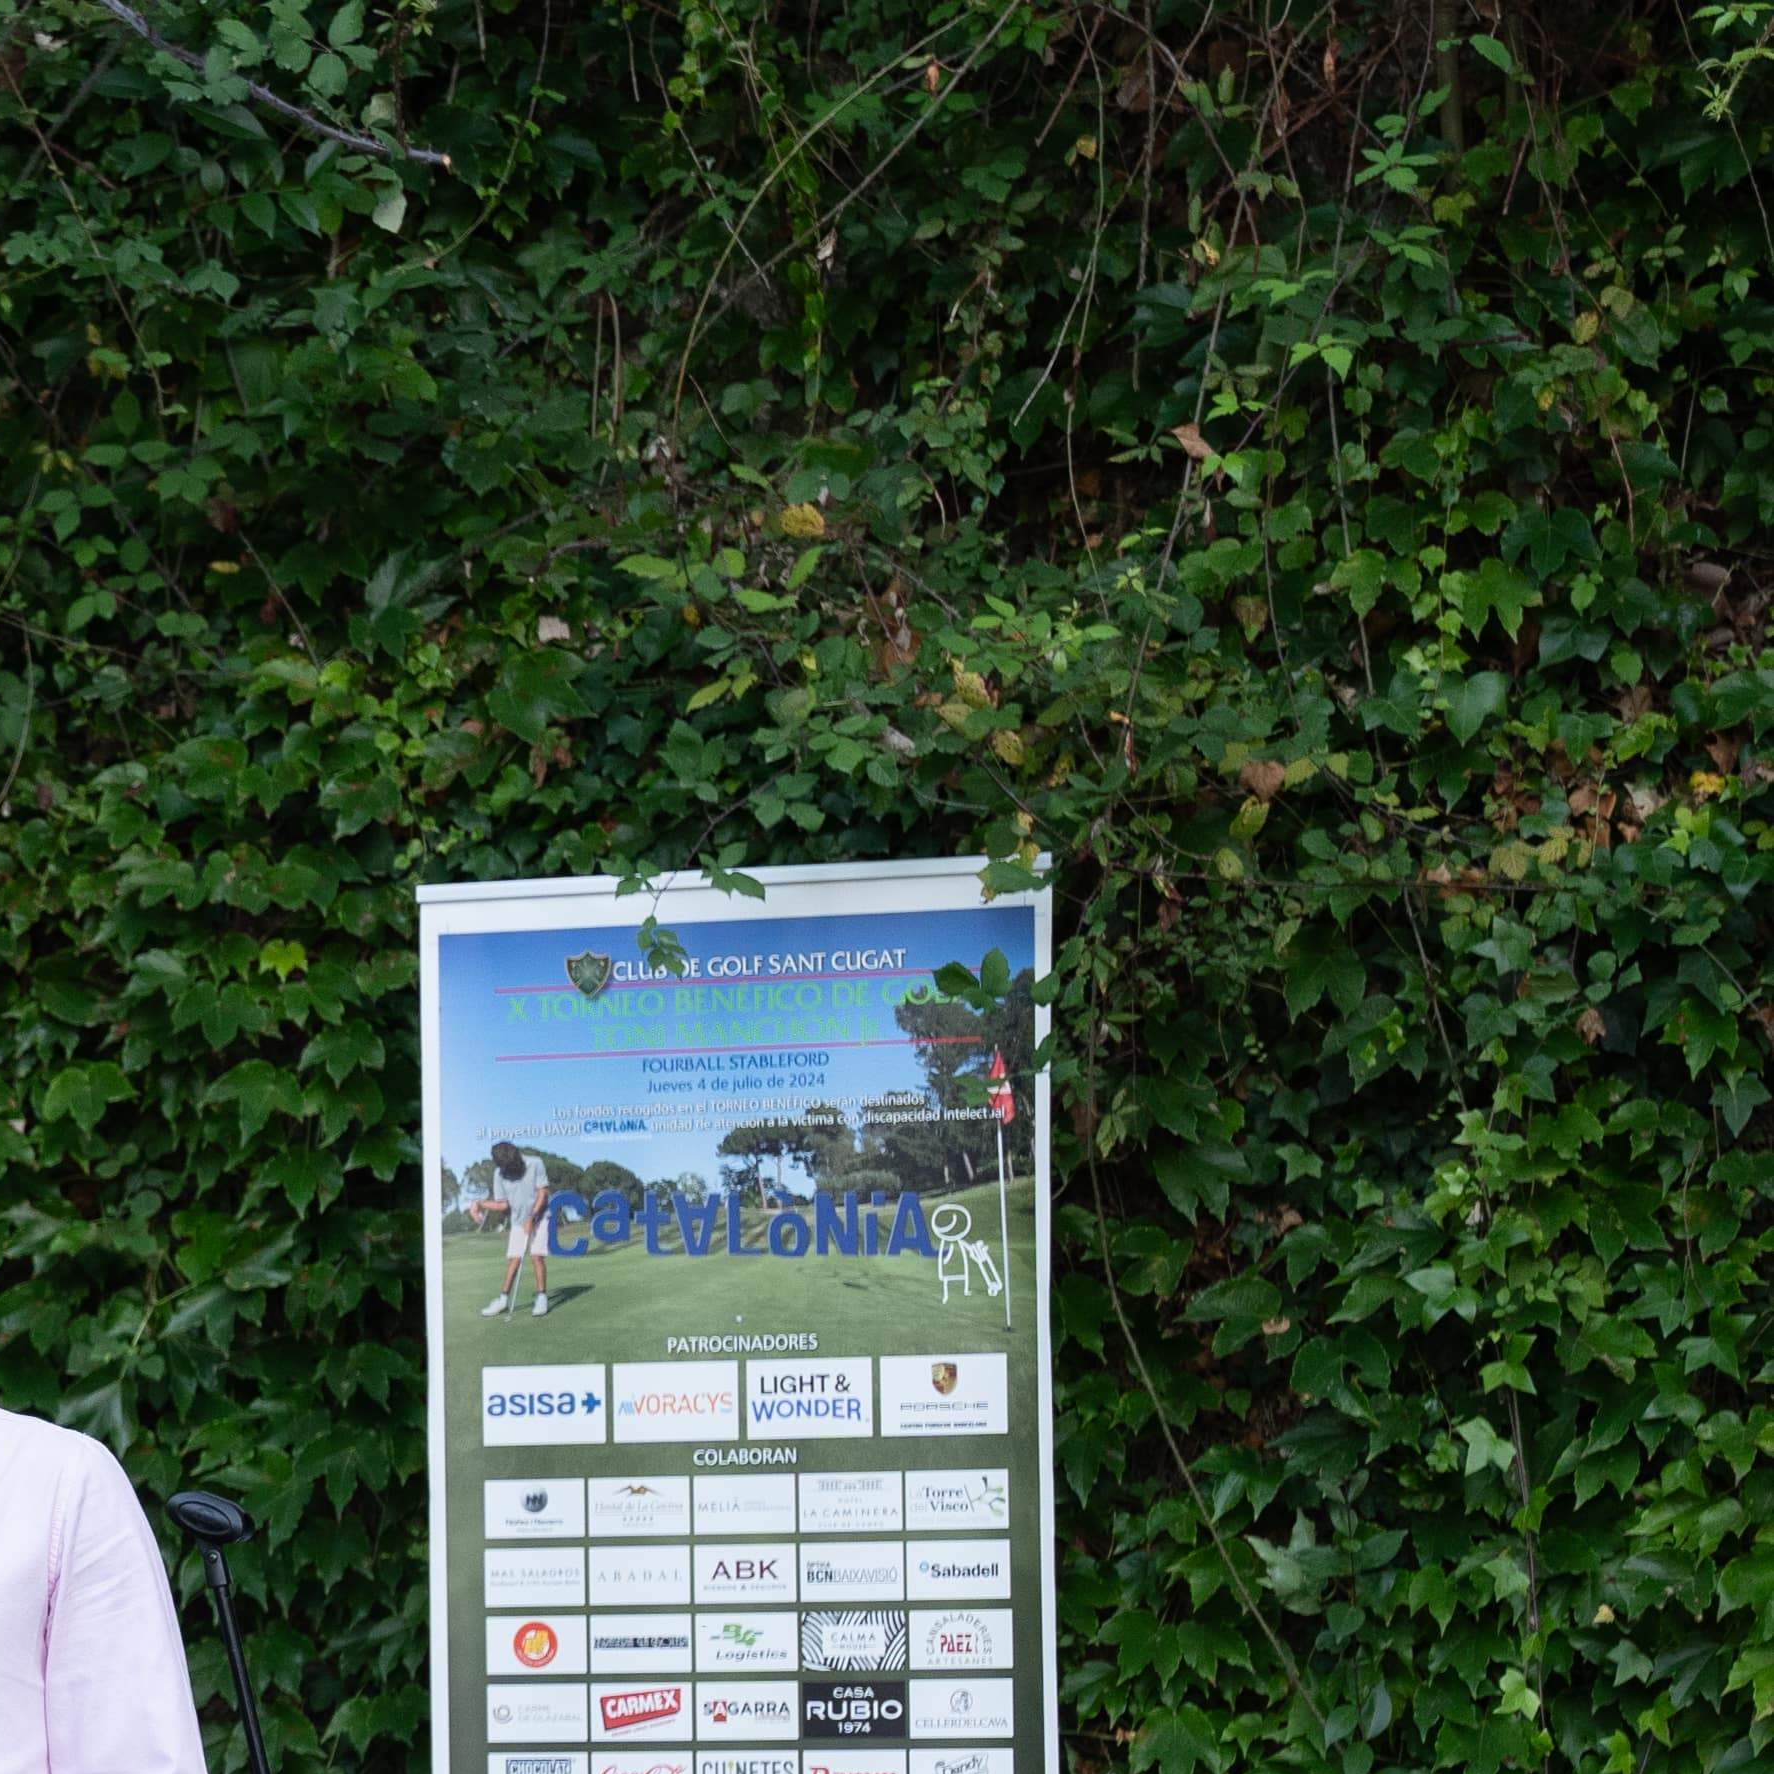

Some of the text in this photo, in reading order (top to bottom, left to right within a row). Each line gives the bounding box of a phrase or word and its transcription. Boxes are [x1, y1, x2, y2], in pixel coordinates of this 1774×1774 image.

[612, 960, 667, 982] CLUB
[707, 954, 764, 977] GOLF
[768, 951, 827, 974] SANT
[831, 948, 907, 971] CUGAT
[536, 988, 665, 1021] TORNEO
[830, 979, 866, 1007] DE
[882, 976, 958, 1007] GOL
[642, 1050, 830, 1074] FOURBALL STABLEFORD
[647, 1073, 826, 1095] Jueves 4 de julio de 2024
[711, 1098, 760, 1112] TORNEO
[860, 1092, 925, 1107] destinados
[489, 1124, 540, 1141] proyecto
[777, 1114, 789, 1127] la
[837, 1113, 860, 1127] con
[862, 1107, 940, 1126] discapacidad
[667, 1333, 819, 1354] PATROCINADORES
[760, 1373, 850, 1395] LIGHT &
[487, 1391, 576, 1417] asisa
[752, 1397, 862, 1423] WONDER
[693, 1447, 797, 1467] COLABORAN
[923, 1485, 964, 1499] Torre
[930, 1500, 969, 1513] Visco
[712, 1559, 779, 1581] ABK
[930, 1562, 999, 1579] Sabadell
[939, 1634, 973, 1653] PAEZ
[716, 1649, 788, 1661] Logistics
[833, 1686, 875, 1699] CASA
[605, 1690, 678, 1719] CARMEX
[703, 1700, 790, 1720] SAGARRA
[806, 1699, 903, 1721] RUBIO
[837, 1722, 872, 1734] 1974
